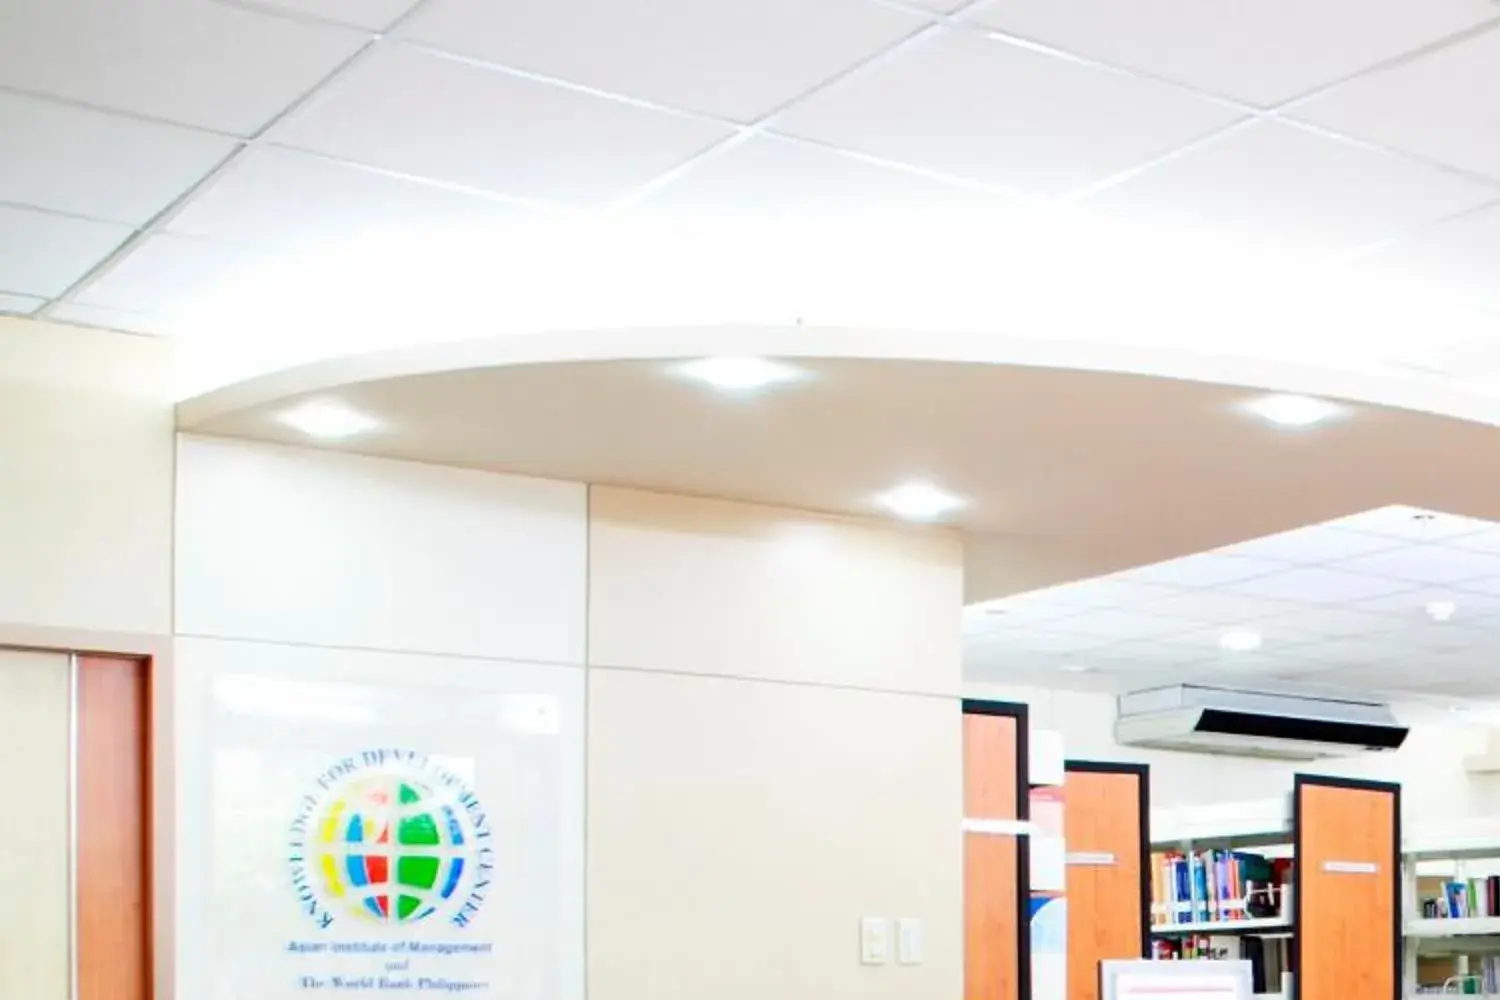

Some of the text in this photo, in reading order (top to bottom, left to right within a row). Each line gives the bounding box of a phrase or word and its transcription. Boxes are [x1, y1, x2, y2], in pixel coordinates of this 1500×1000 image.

[317, 756, 359, 791] FOR
[453, 846, 494, 929] CENTER
[287, 939, 493, 956] Asian Institute of Management
[385, 957, 410, 971] and
[301, 975, 324, 990] The
[332, 975, 374, 990] World
[378, 975, 413, 990] Bank
